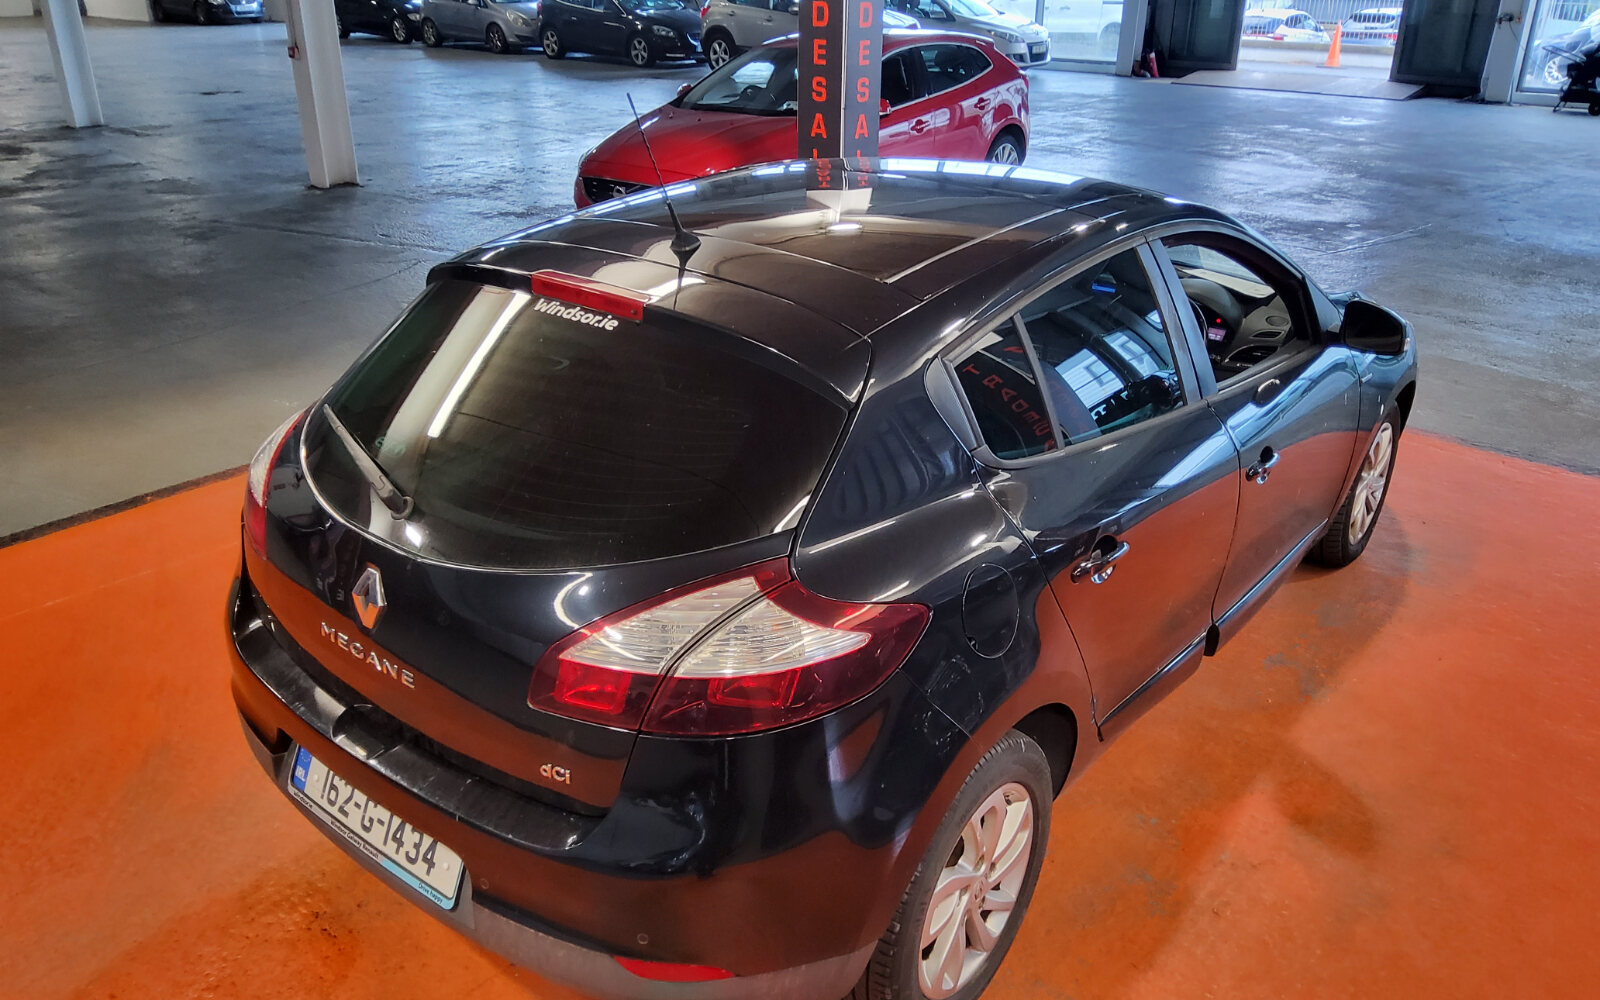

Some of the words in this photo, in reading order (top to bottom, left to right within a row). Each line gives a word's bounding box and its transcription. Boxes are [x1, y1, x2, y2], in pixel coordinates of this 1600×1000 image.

[533, 298, 619, 331] Windsor.ie
[320, 621, 415, 689] MEGANE
[539, 763, 571, 784] dCi
